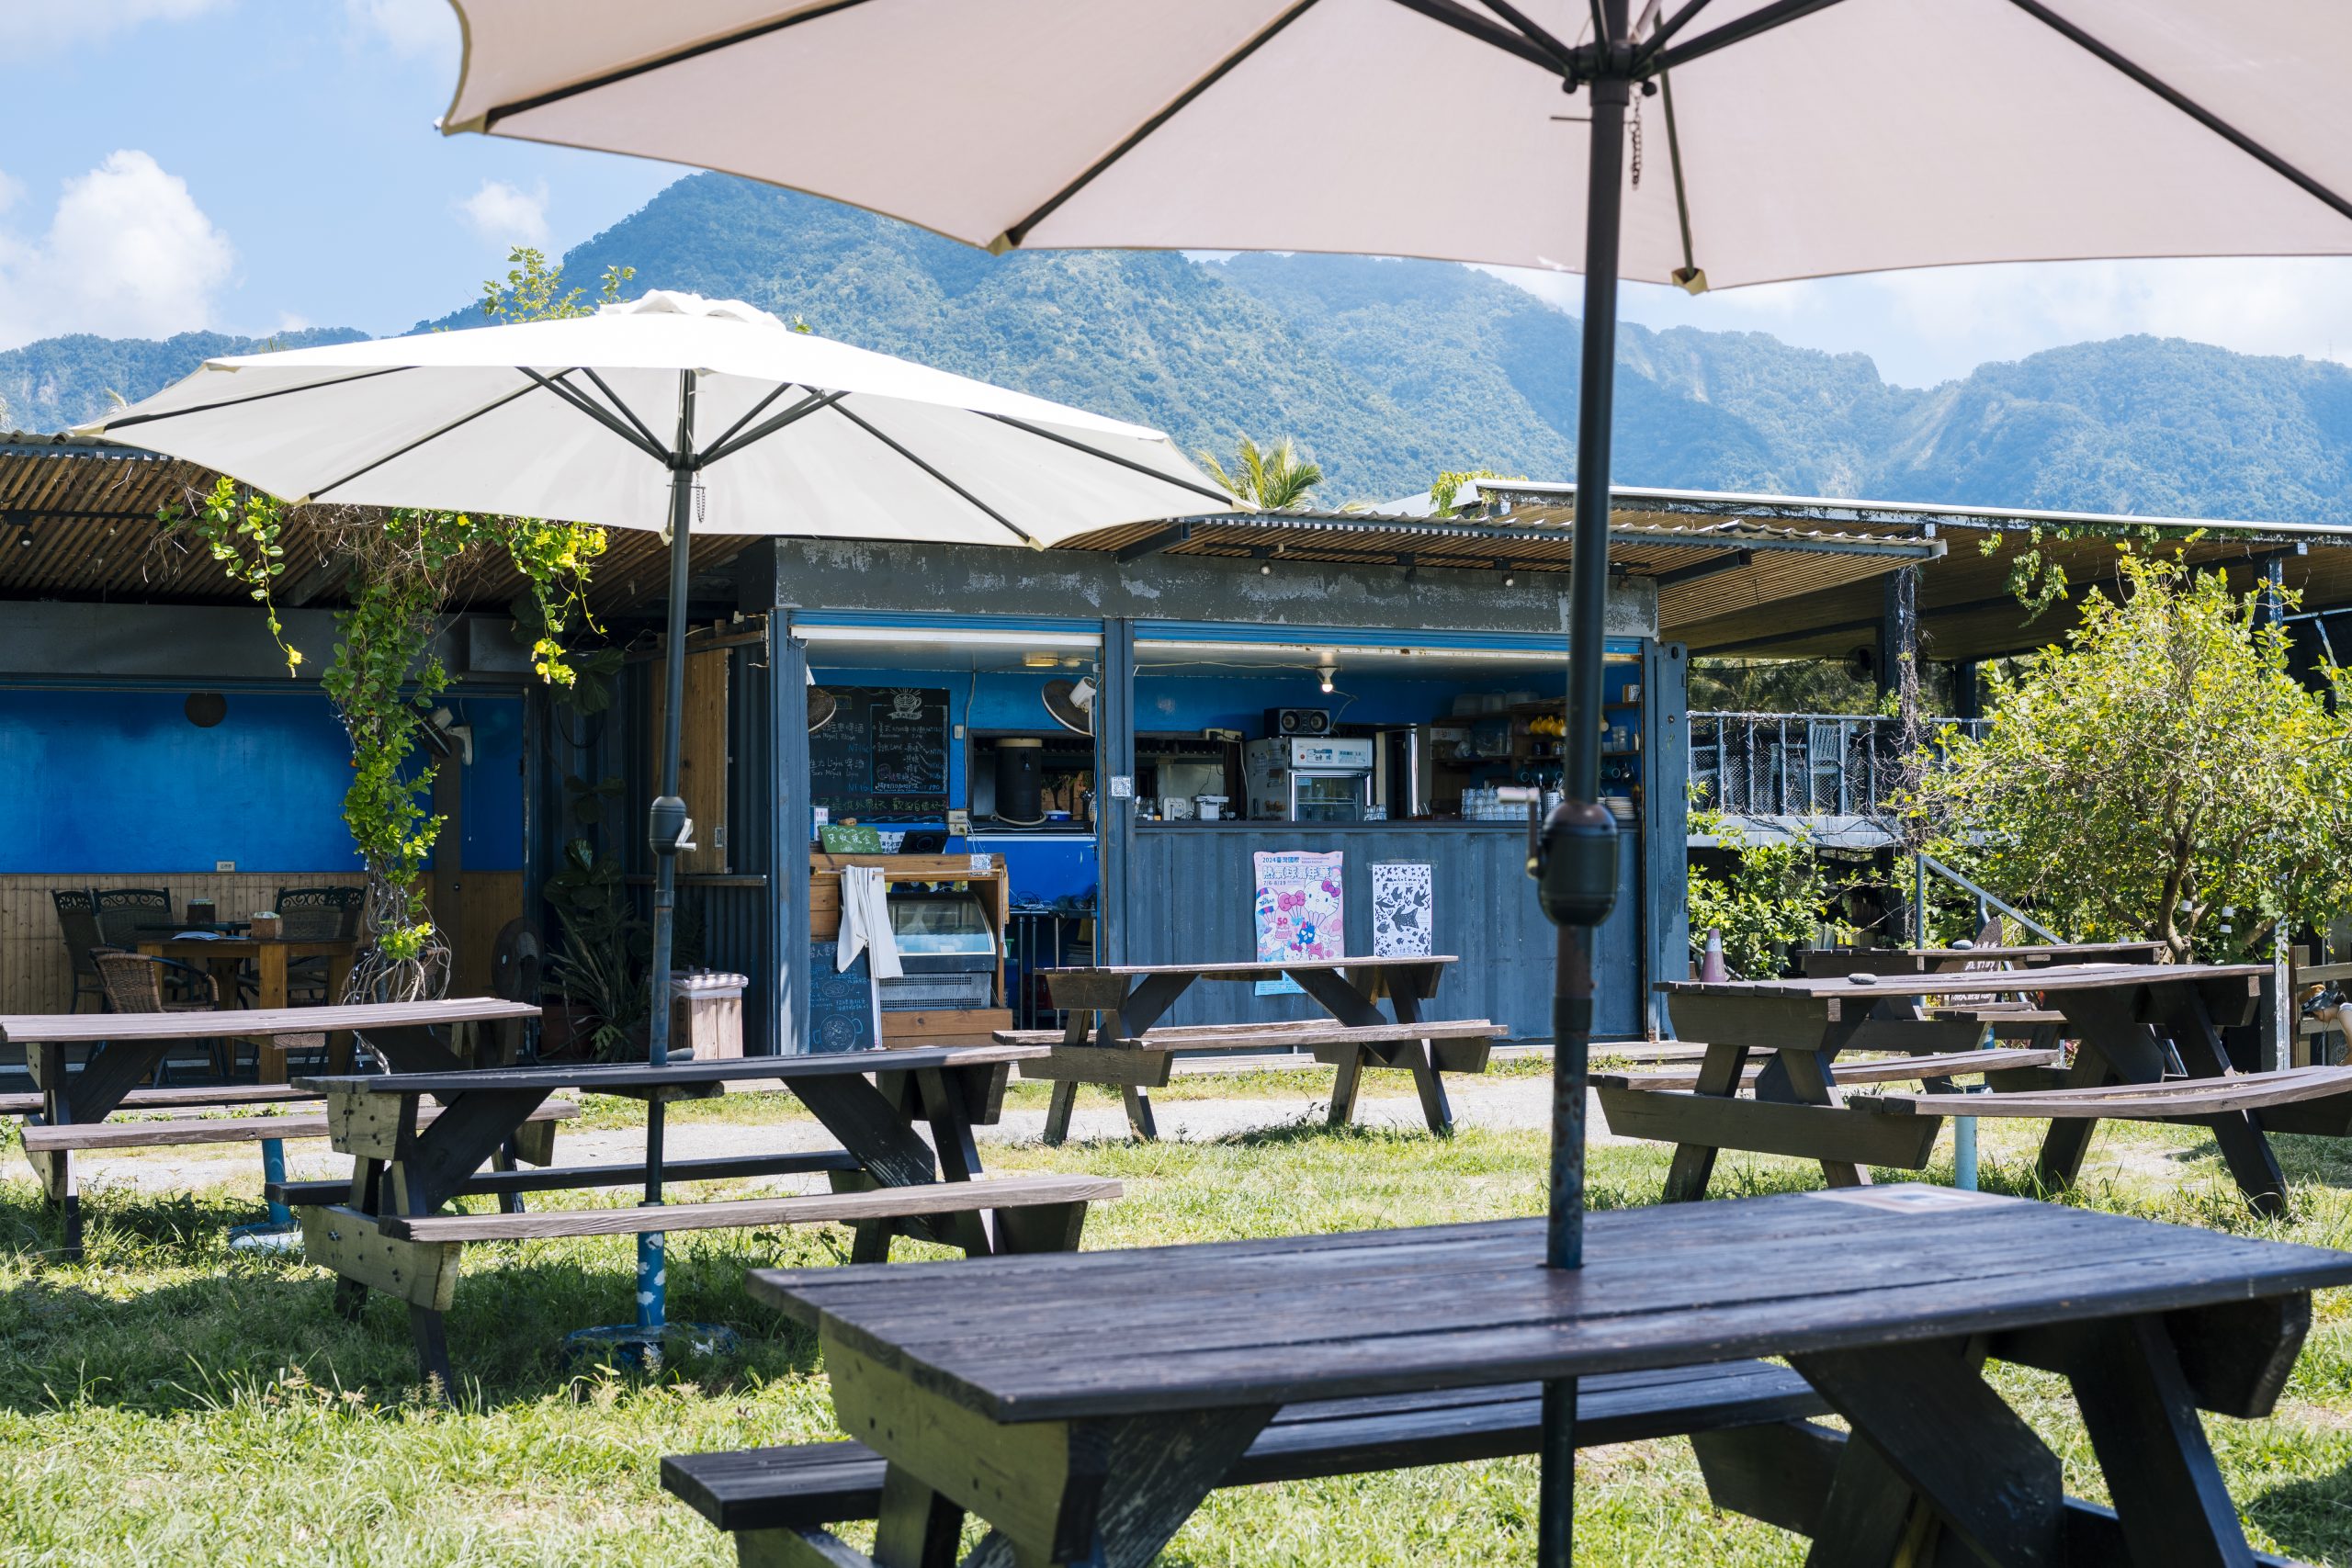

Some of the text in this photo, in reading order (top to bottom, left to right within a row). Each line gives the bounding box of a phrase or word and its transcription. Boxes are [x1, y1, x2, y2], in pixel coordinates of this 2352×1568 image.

[1262, 865, 1331, 880] 熱氣球嘉年華
